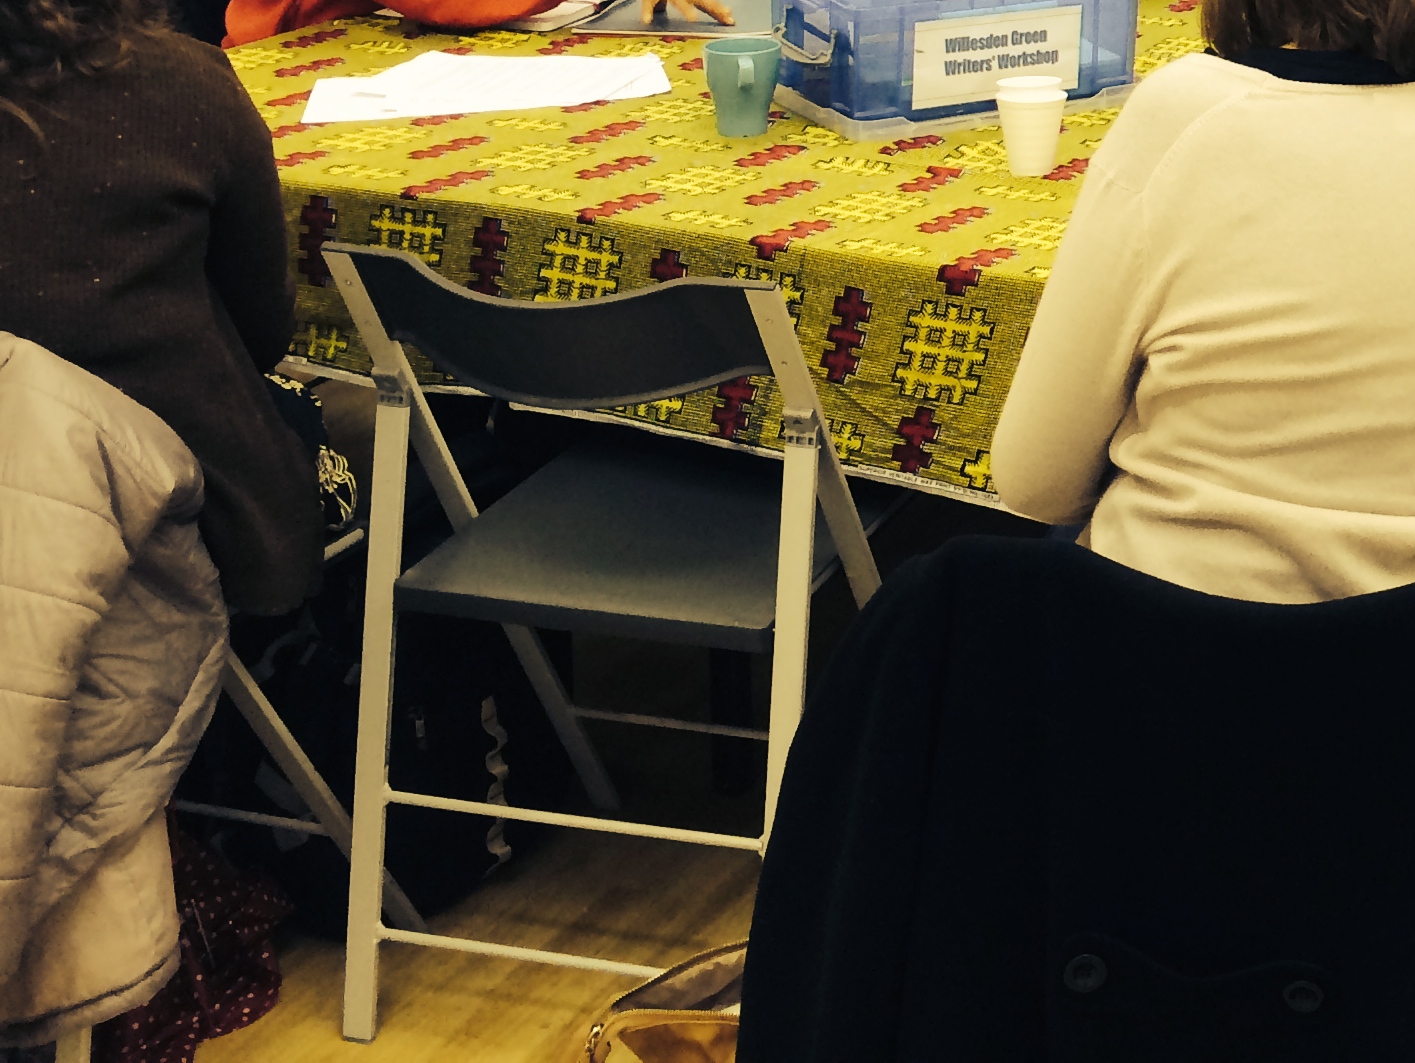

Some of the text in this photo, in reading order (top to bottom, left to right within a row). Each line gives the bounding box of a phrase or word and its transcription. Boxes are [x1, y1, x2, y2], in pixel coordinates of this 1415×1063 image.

[945, 29, 1048, 54] Willesden Green
[944, 50, 1059, 77] Writers' Workshop
